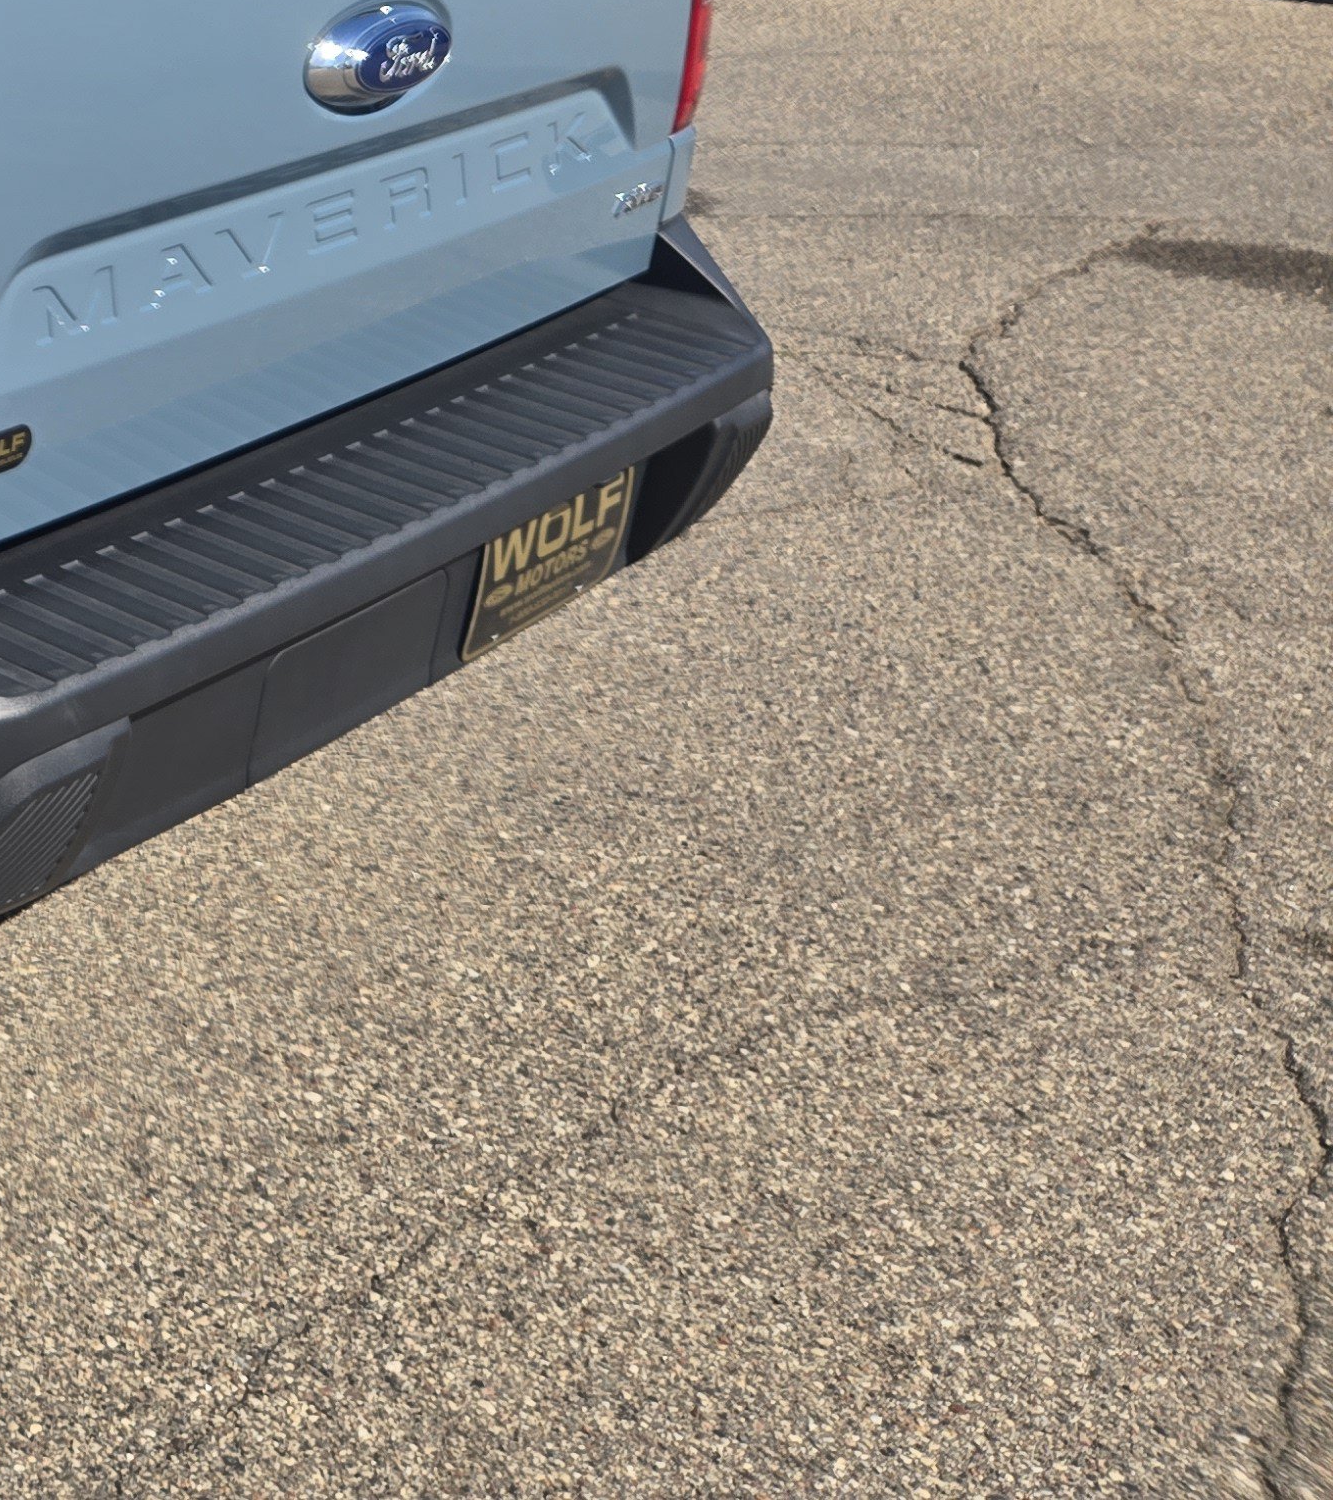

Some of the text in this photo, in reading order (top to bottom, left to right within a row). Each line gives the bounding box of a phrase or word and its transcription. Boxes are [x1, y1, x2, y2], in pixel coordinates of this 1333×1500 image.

[379, 30, 437, 83] Ford
[32, 111, 593, 347] MAVERICK
[494, 471, 625, 582] WOLF
[514, 541, 588, 596] MOTORS
